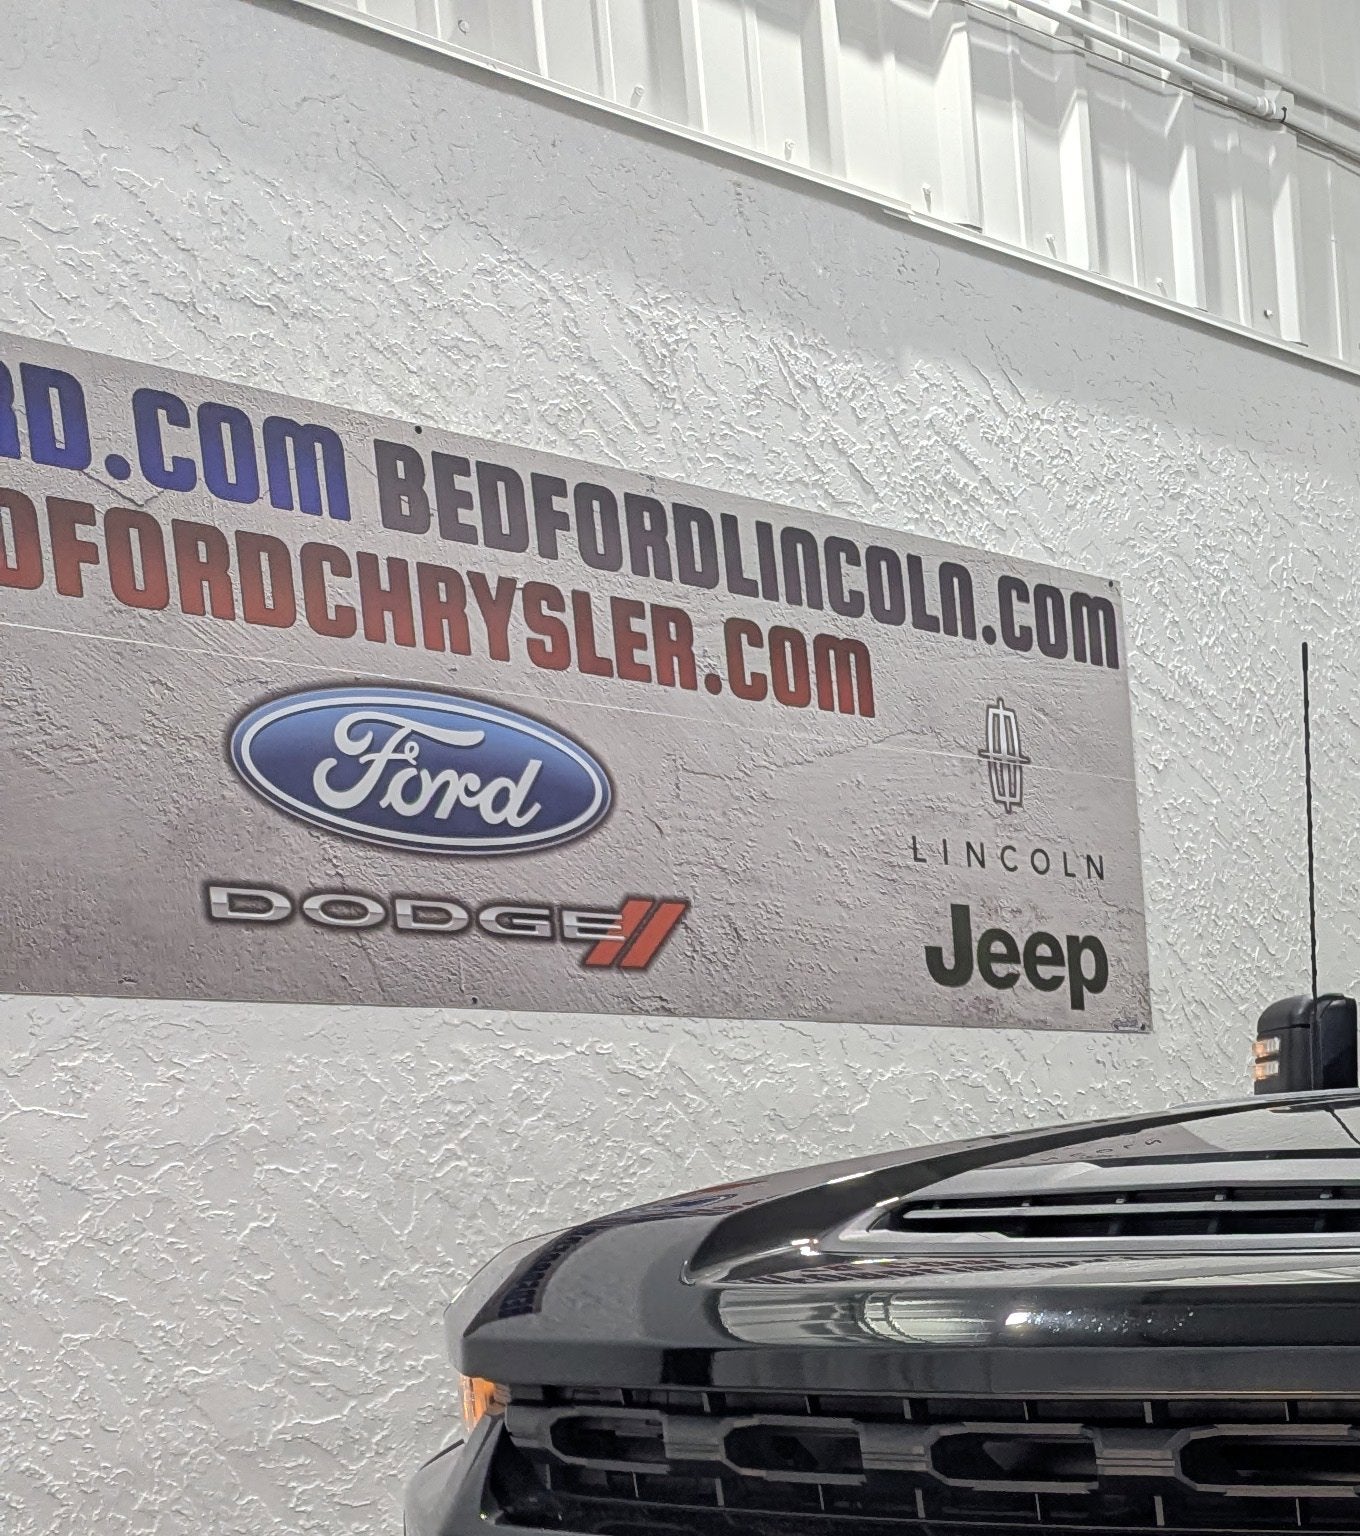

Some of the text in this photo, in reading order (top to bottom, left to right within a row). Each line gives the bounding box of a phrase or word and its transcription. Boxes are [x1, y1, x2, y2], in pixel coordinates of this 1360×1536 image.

[312, 710, 544, 829] Ford
[911, 835, 1105, 881] LINCOLN
[208, 885, 627, 942] DODGE
[924, 902, 1109, 1011] Jeep
